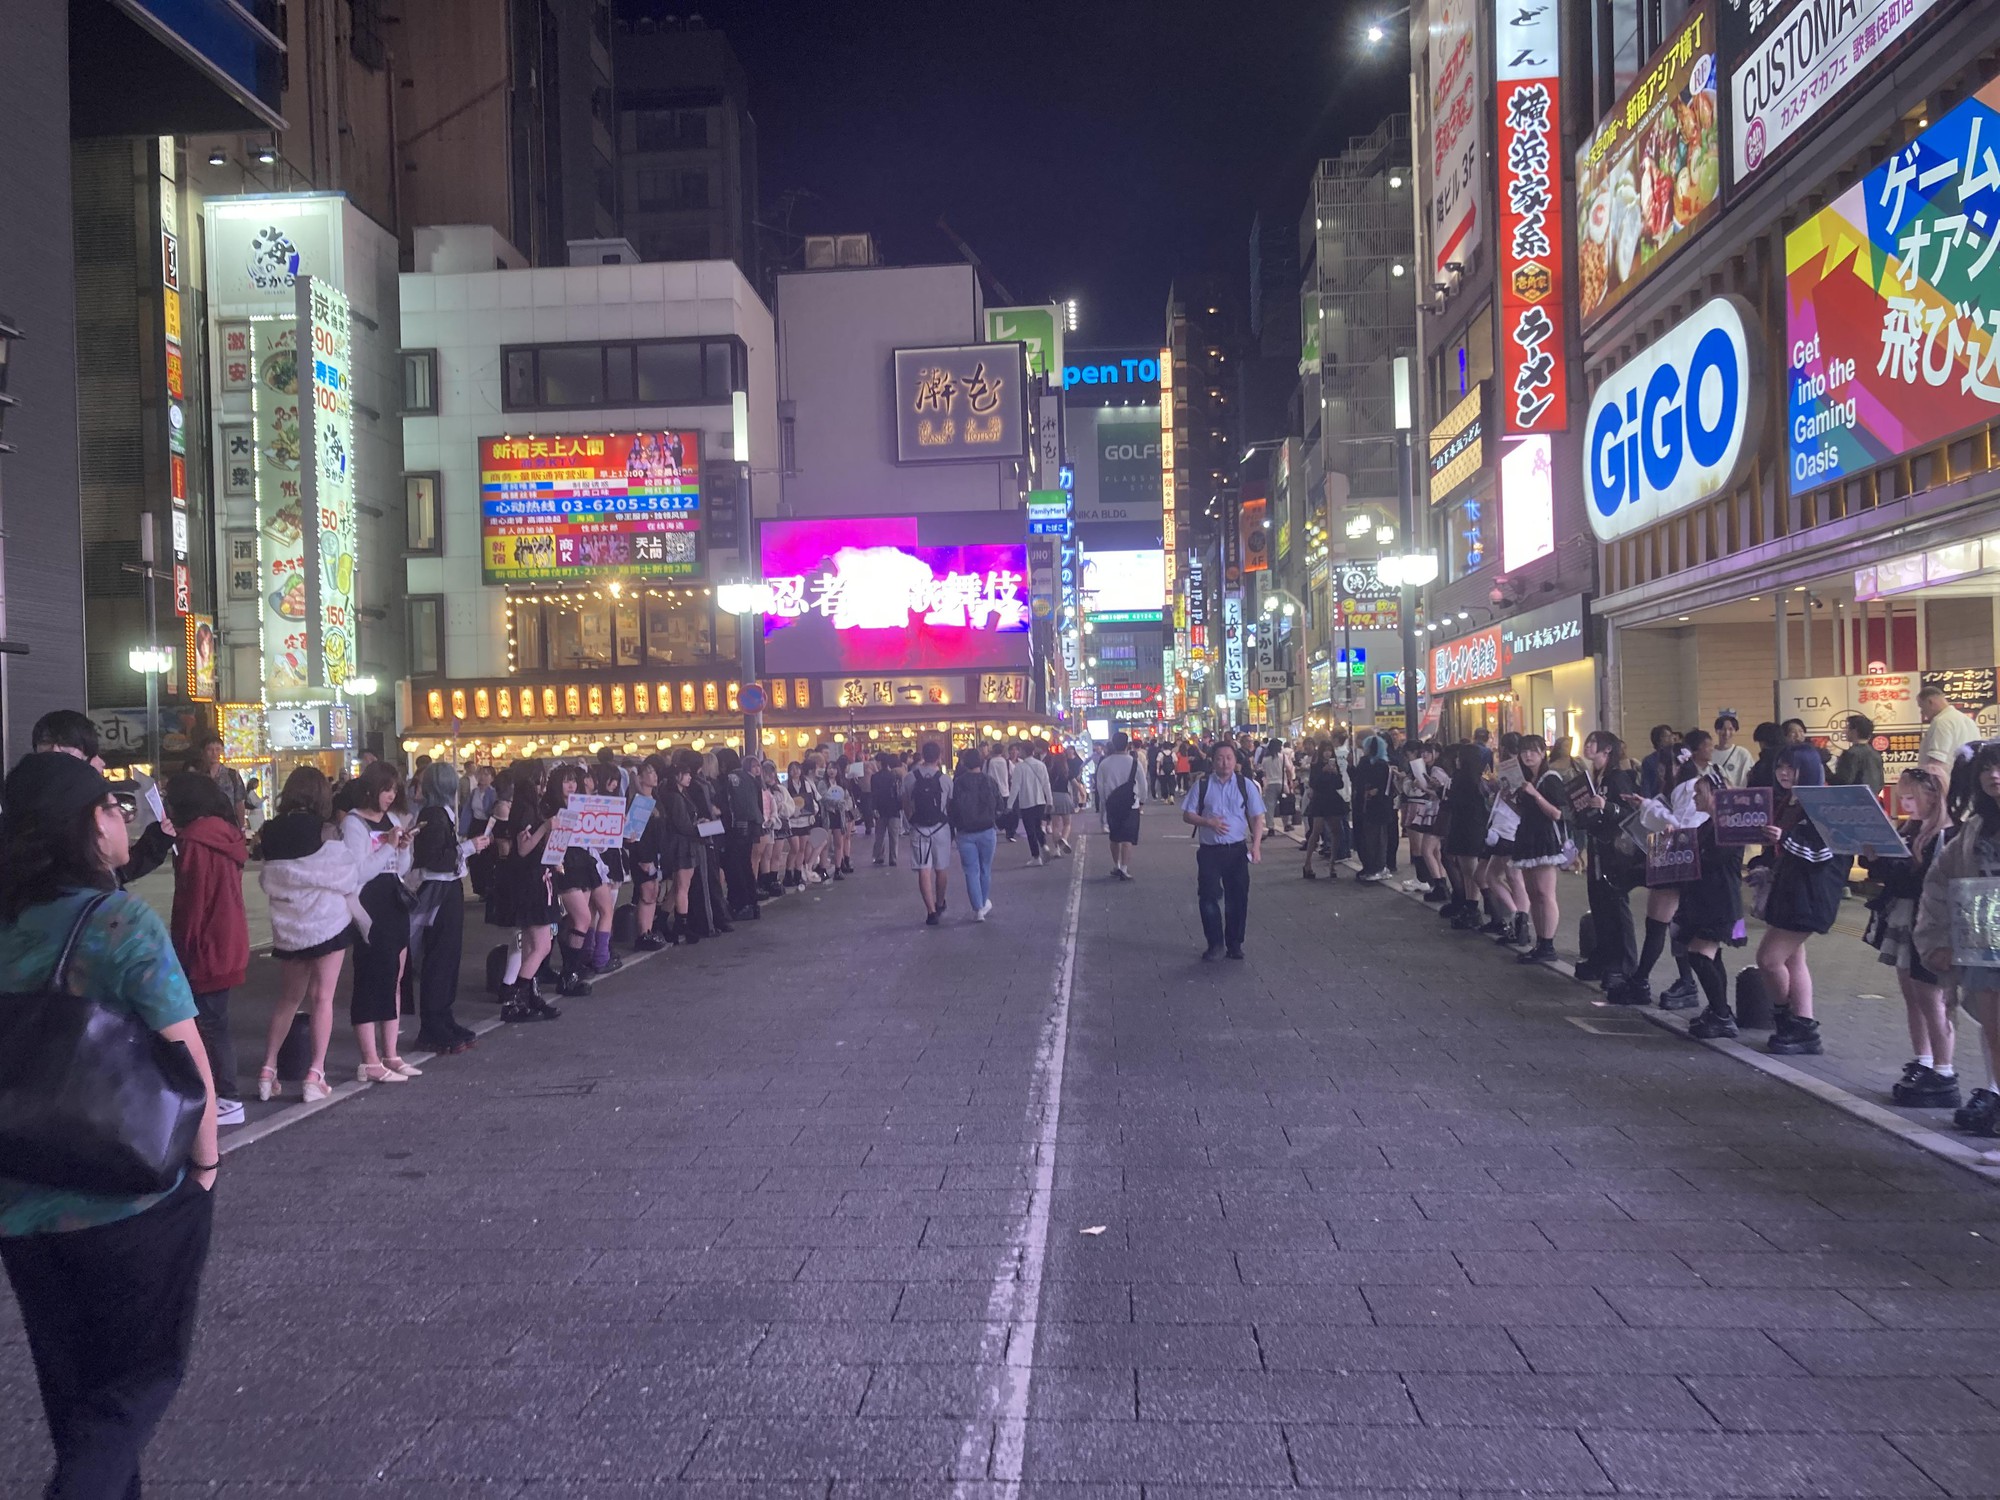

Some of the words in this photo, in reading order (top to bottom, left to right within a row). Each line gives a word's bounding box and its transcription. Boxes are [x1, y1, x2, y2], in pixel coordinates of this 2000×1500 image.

[1626, 12, 1705, 131] 新宿アジア横丁
[1781, 54, 1848, 131] カスタマカフェ
[1507, 84, 1550, 259] 横浜家系
[1879, 116, 2000, 236] ゲーム
[314, 326, 334, 356] 90
[1792, 333, 1821, 371] Get
[315, 359, 339, 390] 寿司
[1514, 306, 1555, 428] ラーメン
[1798, 369, 1826, 406] into
[1828, 356, 1856, 394] the
[315, 385, 337, 413] 100
[1794, 397, 1857, 445] Gaming
[1436, 421, 1482, 470] 山下本気うどん
[1795, 443, 1839, 481] Oasis
[561, 496, 694, 512] 03-6205-5612
[1030, 507, 1065, 516] FamilyMart
[1101, 509, 1127, 519] BLDG
[321, 507, 338, 531] 50
[1045, 523, 1064, 532] たばこ
[1251, 556, 1264, 566] 4F
[326, 606, 345, 626] 150
[1258, 622, 1273, 665] ちから
[1513, 620, 1581, 654] 山下本気うどん
[1865, 676, 1902, 687] カラオケ
[1922, 669, 1994, 682] インターネット
[1794, 696, 1832, 709] TOA
[1857, 688, 1911, 704] まねきねこ
[1978, 714, 1997, 725] 04
[1881, 751, 1920, 763] ネットカフェ
